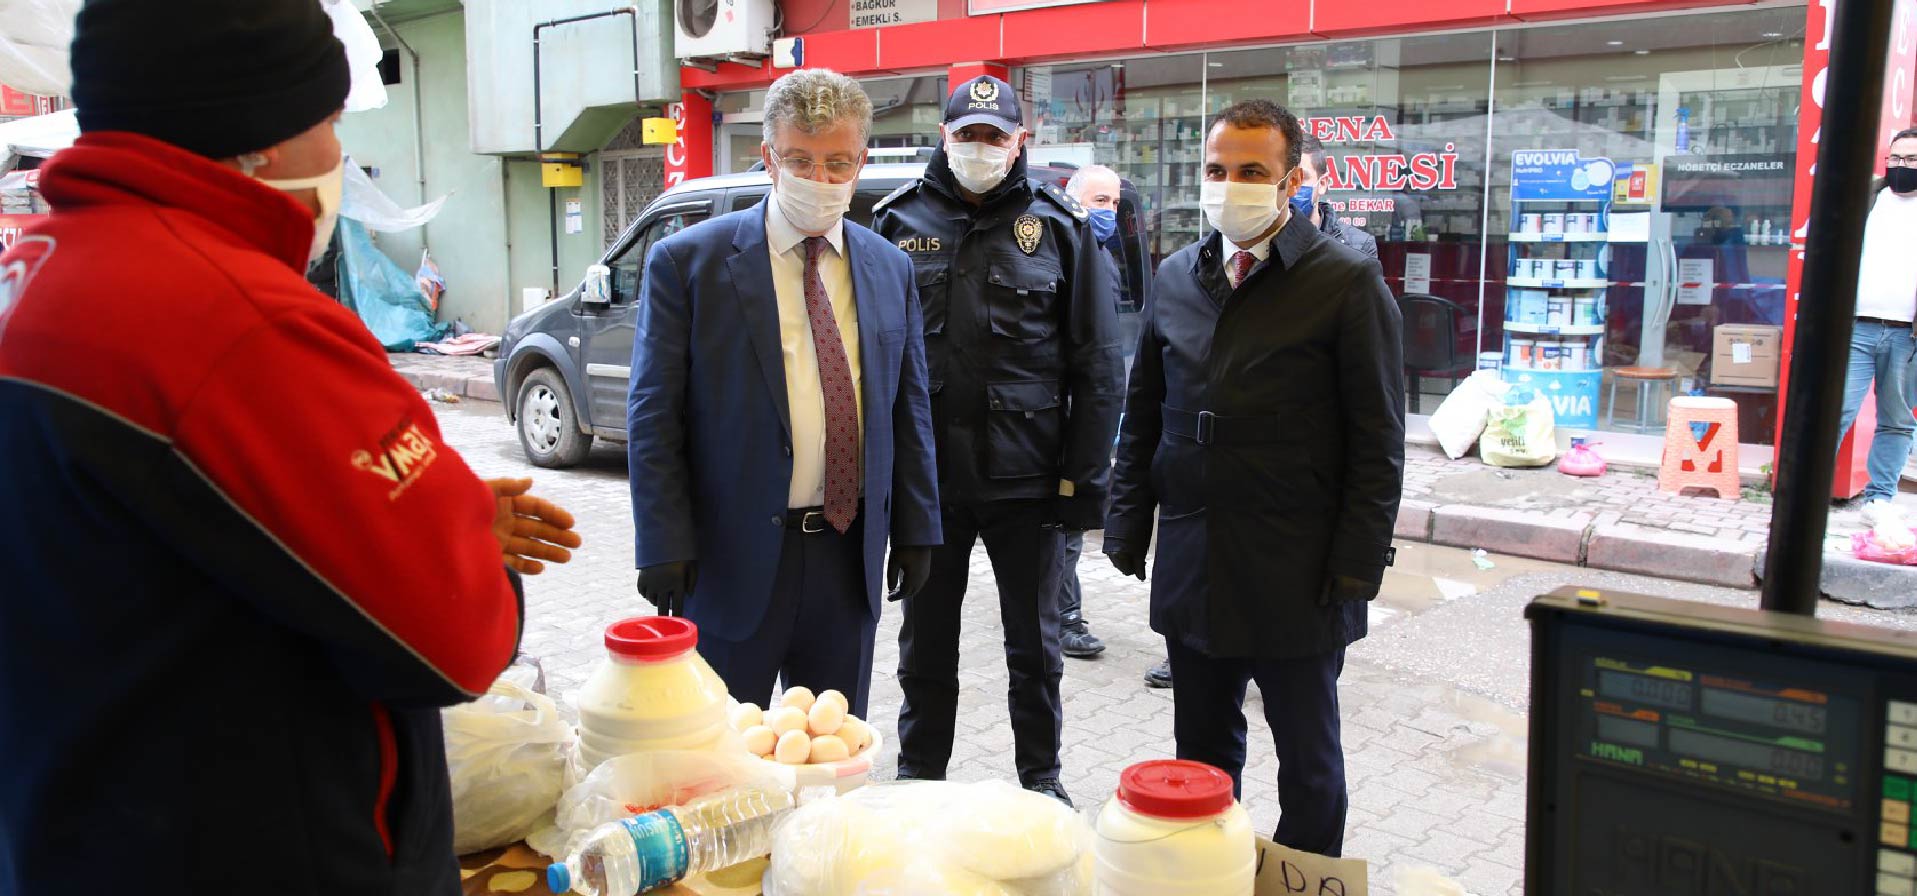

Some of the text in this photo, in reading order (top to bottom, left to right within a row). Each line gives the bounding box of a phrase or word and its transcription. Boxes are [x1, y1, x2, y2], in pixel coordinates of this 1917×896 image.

[1515, 153, 1577, 166] EVOLVIA
[1723, 161, 1784, 171] ECZANELER
[1349, 199, 1394, 212] BEKAR
